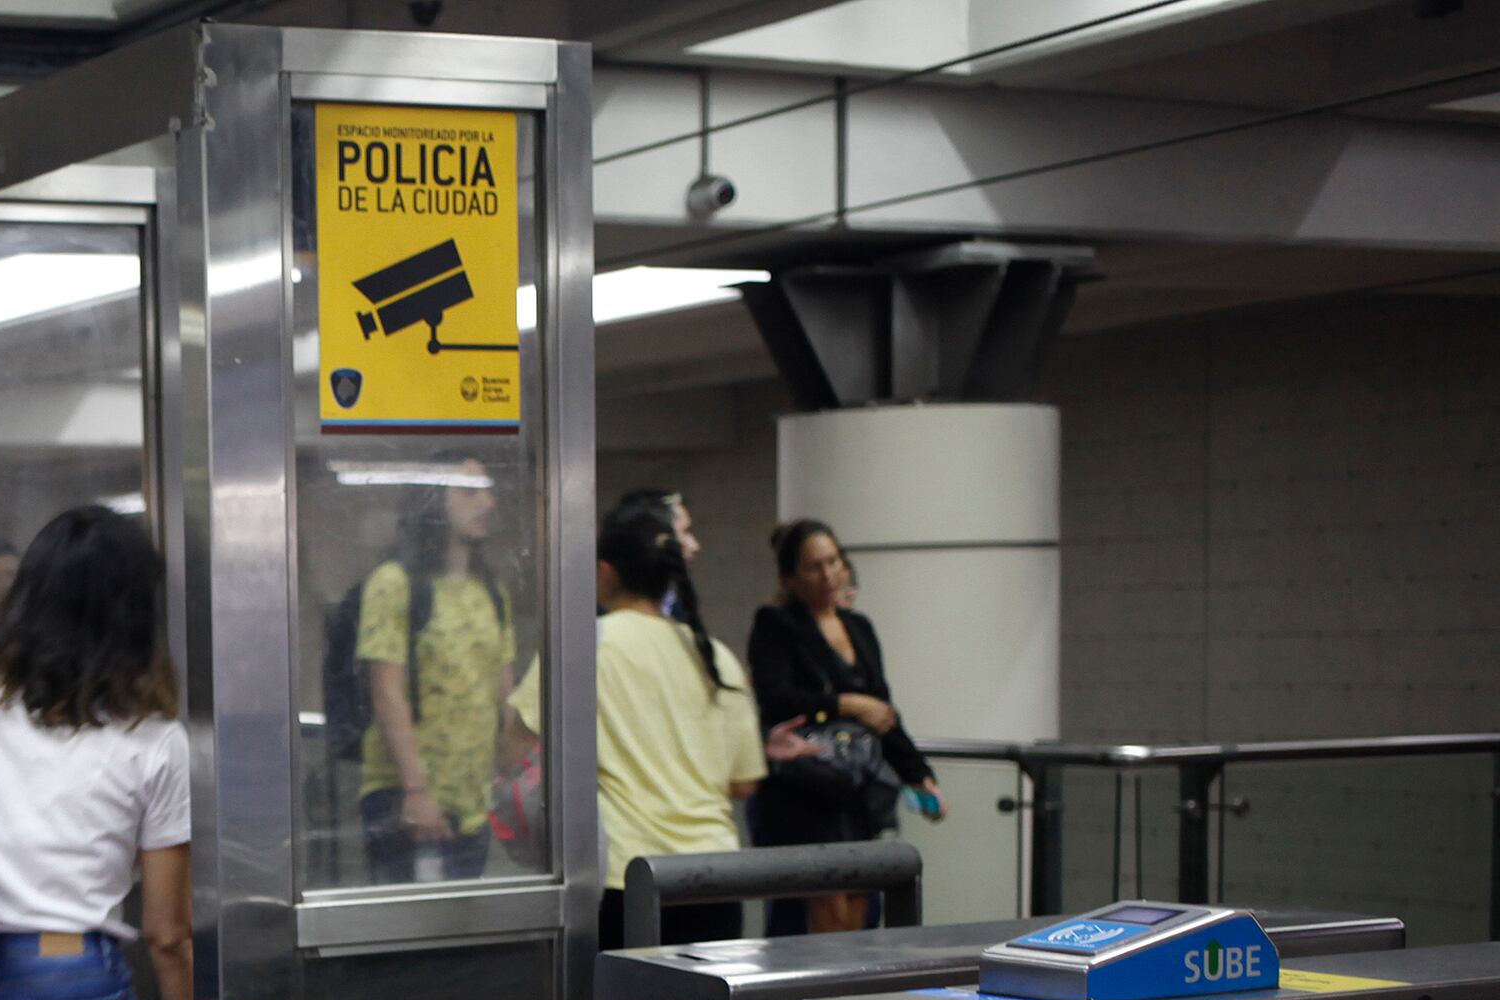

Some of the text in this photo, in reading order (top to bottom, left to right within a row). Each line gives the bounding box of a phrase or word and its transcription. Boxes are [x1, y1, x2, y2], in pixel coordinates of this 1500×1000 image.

[337, 124, 381, 138] ESPACIO
[459, 130, 480, 142] POR
[482, 131, 494, 143] LA
[338, 140, 495, 187] POLICIA
[338, 186, 498, 216] DE LA CIUDAD
[1184, 944, 1262, 984] SUBE
